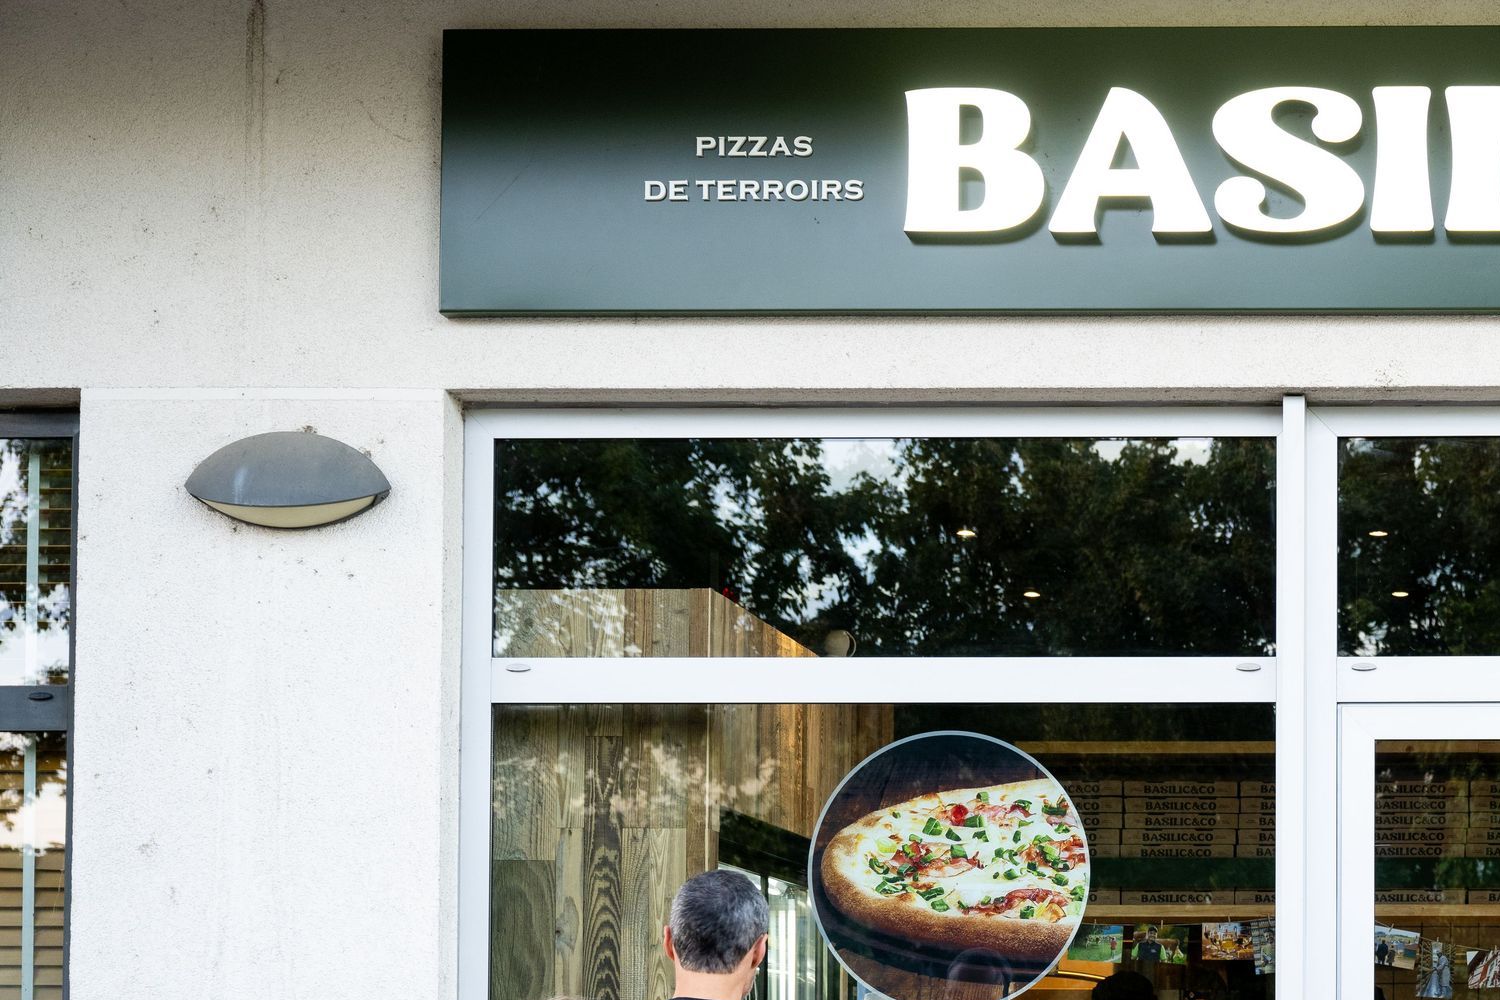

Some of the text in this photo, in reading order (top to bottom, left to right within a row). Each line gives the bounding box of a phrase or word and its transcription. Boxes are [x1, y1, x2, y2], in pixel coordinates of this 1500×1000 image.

[696, 136, 813, 158] PIZZAS
[644, 179, 864, 202] DE TERROIRS
[1144, 785, 1215, 794] BASILIC&CO
[1145, 802, 1217, 811] BASILIC&CO
[1145, 817, 1217, 826] BASILIC&CO
[1142, 833, 1214, 842] BASILIC&CO
[1140, 849, 1212, 857] BASILIC&CO
[1375, 848, 1442, 856] ASILIC&CO
